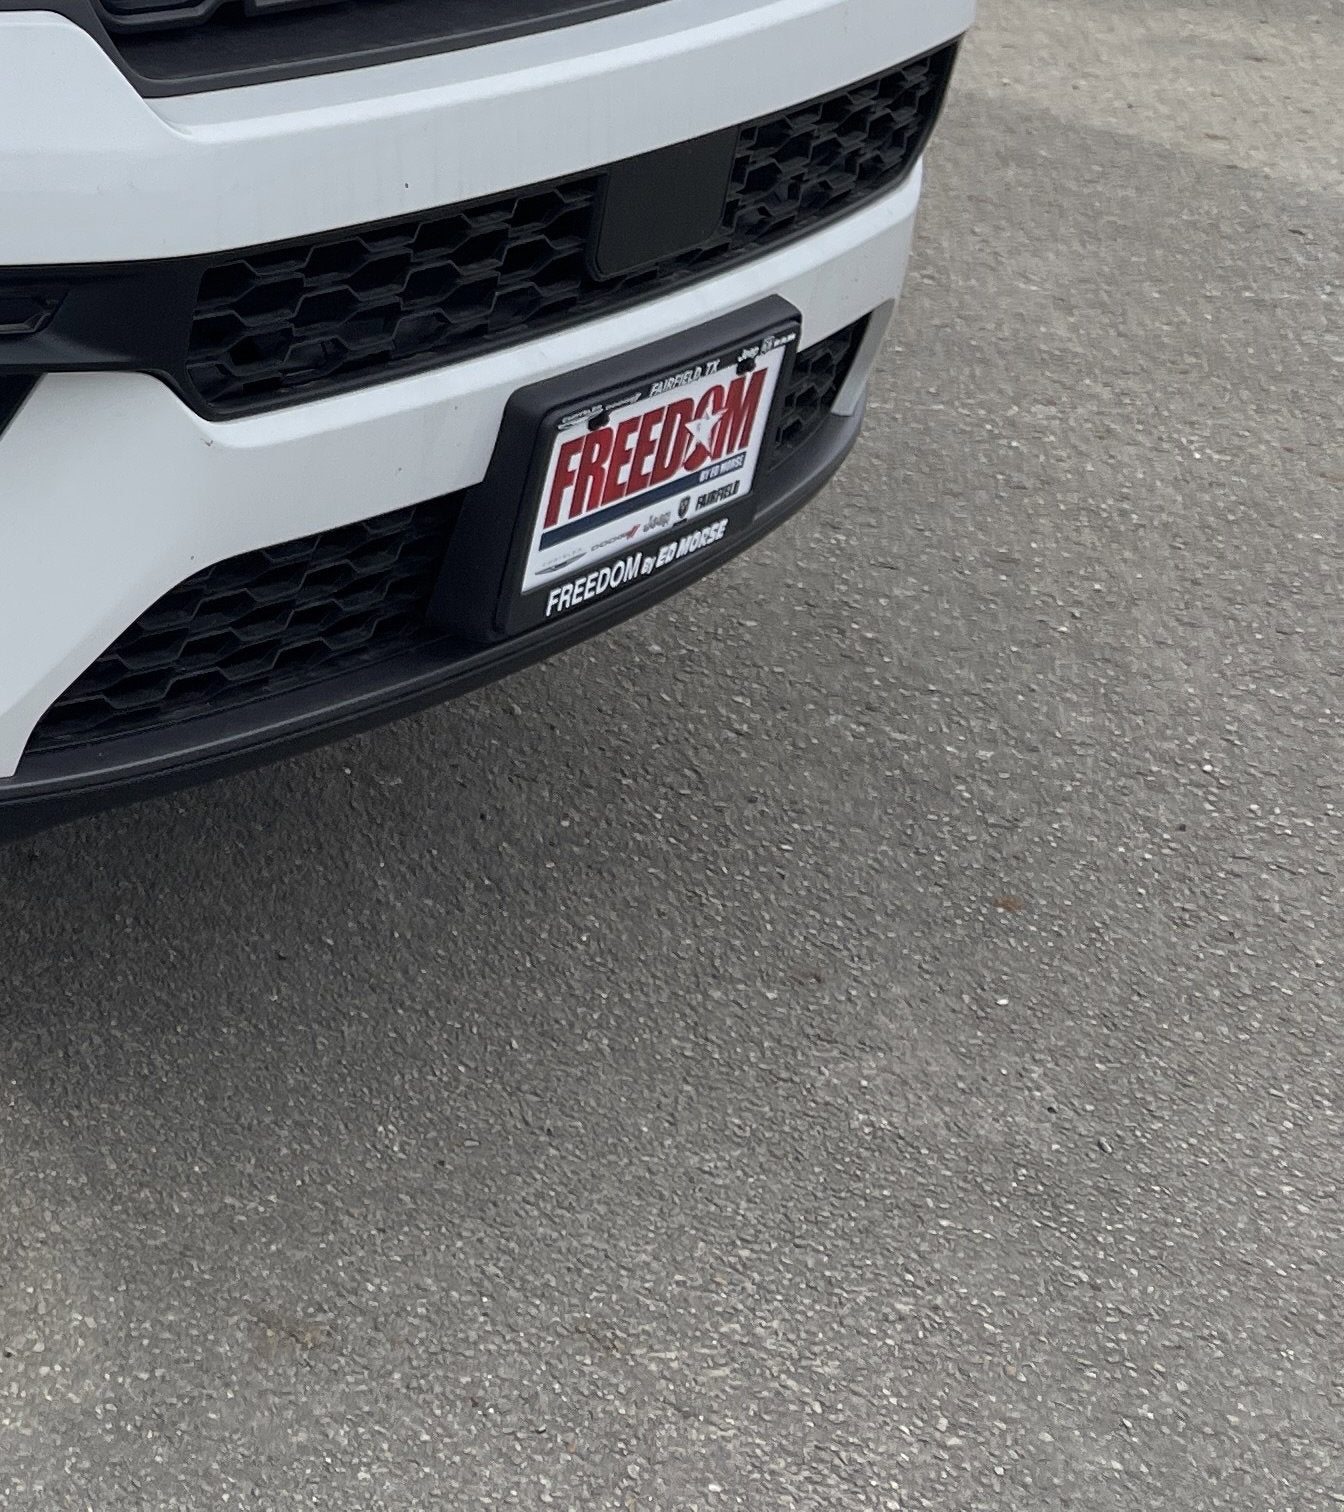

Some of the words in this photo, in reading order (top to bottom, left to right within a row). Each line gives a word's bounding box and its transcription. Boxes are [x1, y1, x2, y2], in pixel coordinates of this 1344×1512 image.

[706, 359, 721, 379] TX
[543, 367, 768, 529] FREEDOM
[720, 454, 744, 474] MORSE
[695, 480, 740, 511] FAIRFIELD
[545, 552, 642, 617] FREEDOM
[656, 541, 678, 568] ED
[675, 518, 729, 560] MORSE
